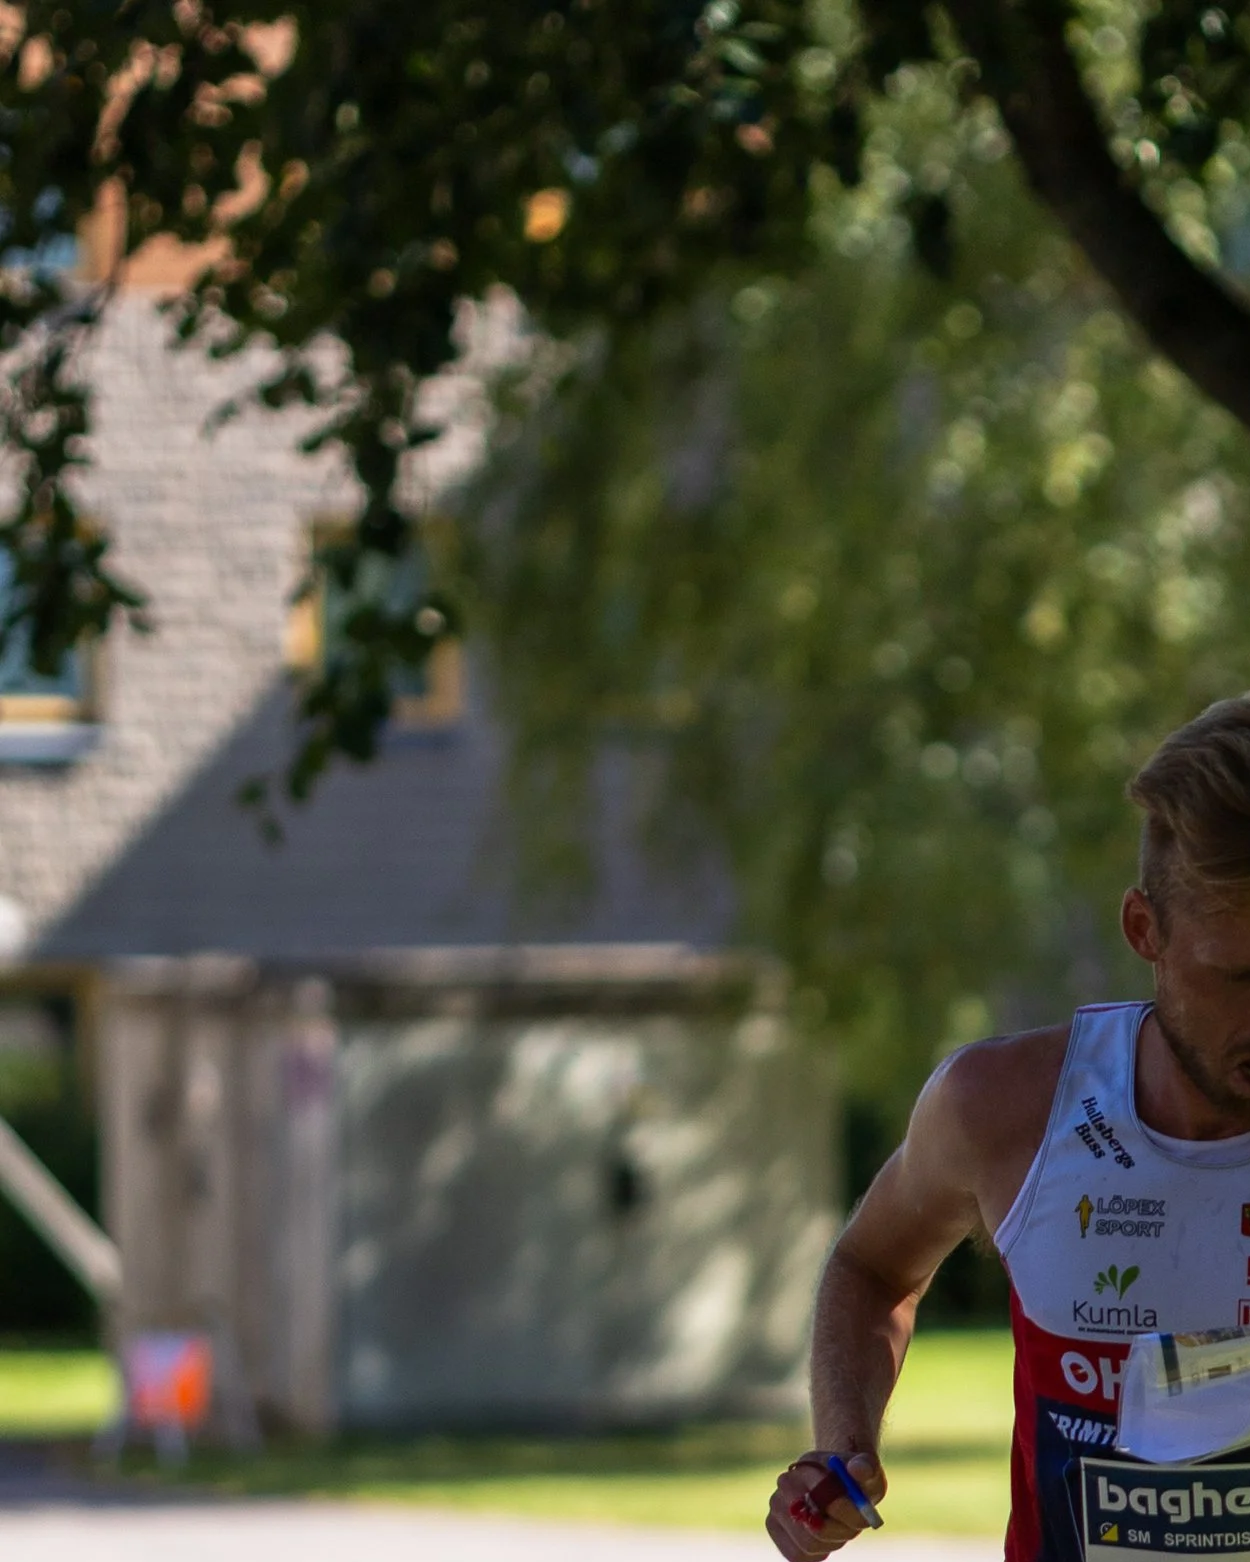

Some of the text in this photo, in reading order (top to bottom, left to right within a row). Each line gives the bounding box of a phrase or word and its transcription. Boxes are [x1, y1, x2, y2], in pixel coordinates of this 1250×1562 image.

[1075, 1122, 1106, 1159] Buss
[1082, 1096, 1135, 1169] Hallsbergs
[1096, 1194, 1166, 1217] LÖPEX
[1095, 1219, 1165, 1238] SPORT
[1073, 1299, 1158, 1329] Kumla
[1127, 1529, 1151, 1544] SM
